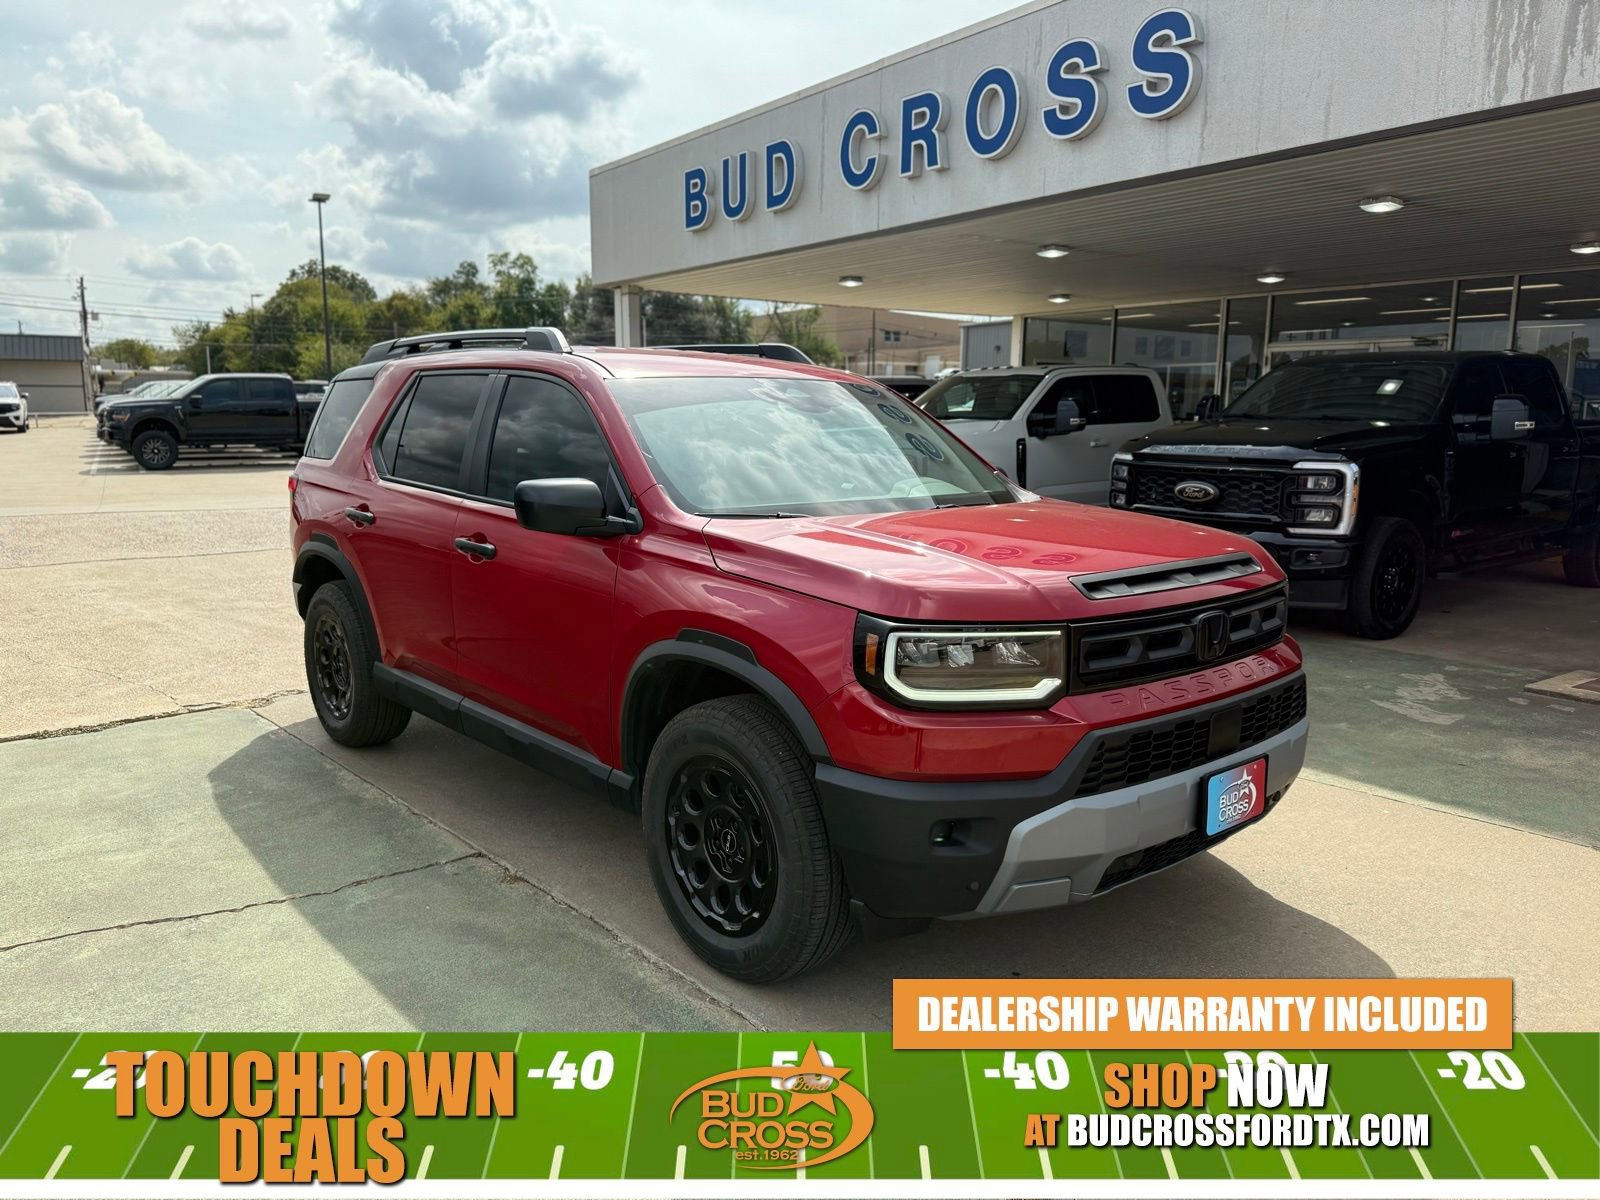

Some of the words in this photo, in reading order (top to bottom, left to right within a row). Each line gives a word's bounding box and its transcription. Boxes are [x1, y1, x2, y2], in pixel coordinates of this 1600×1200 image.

[683, 138, 802, 232] BUD
[839, 7, 1204, 191] CROSS
[1183, 486, 1206, 498] Ford
[1219, 791, 1239, 808] BUD
[1218, 799, 1249, 821] CROSS
